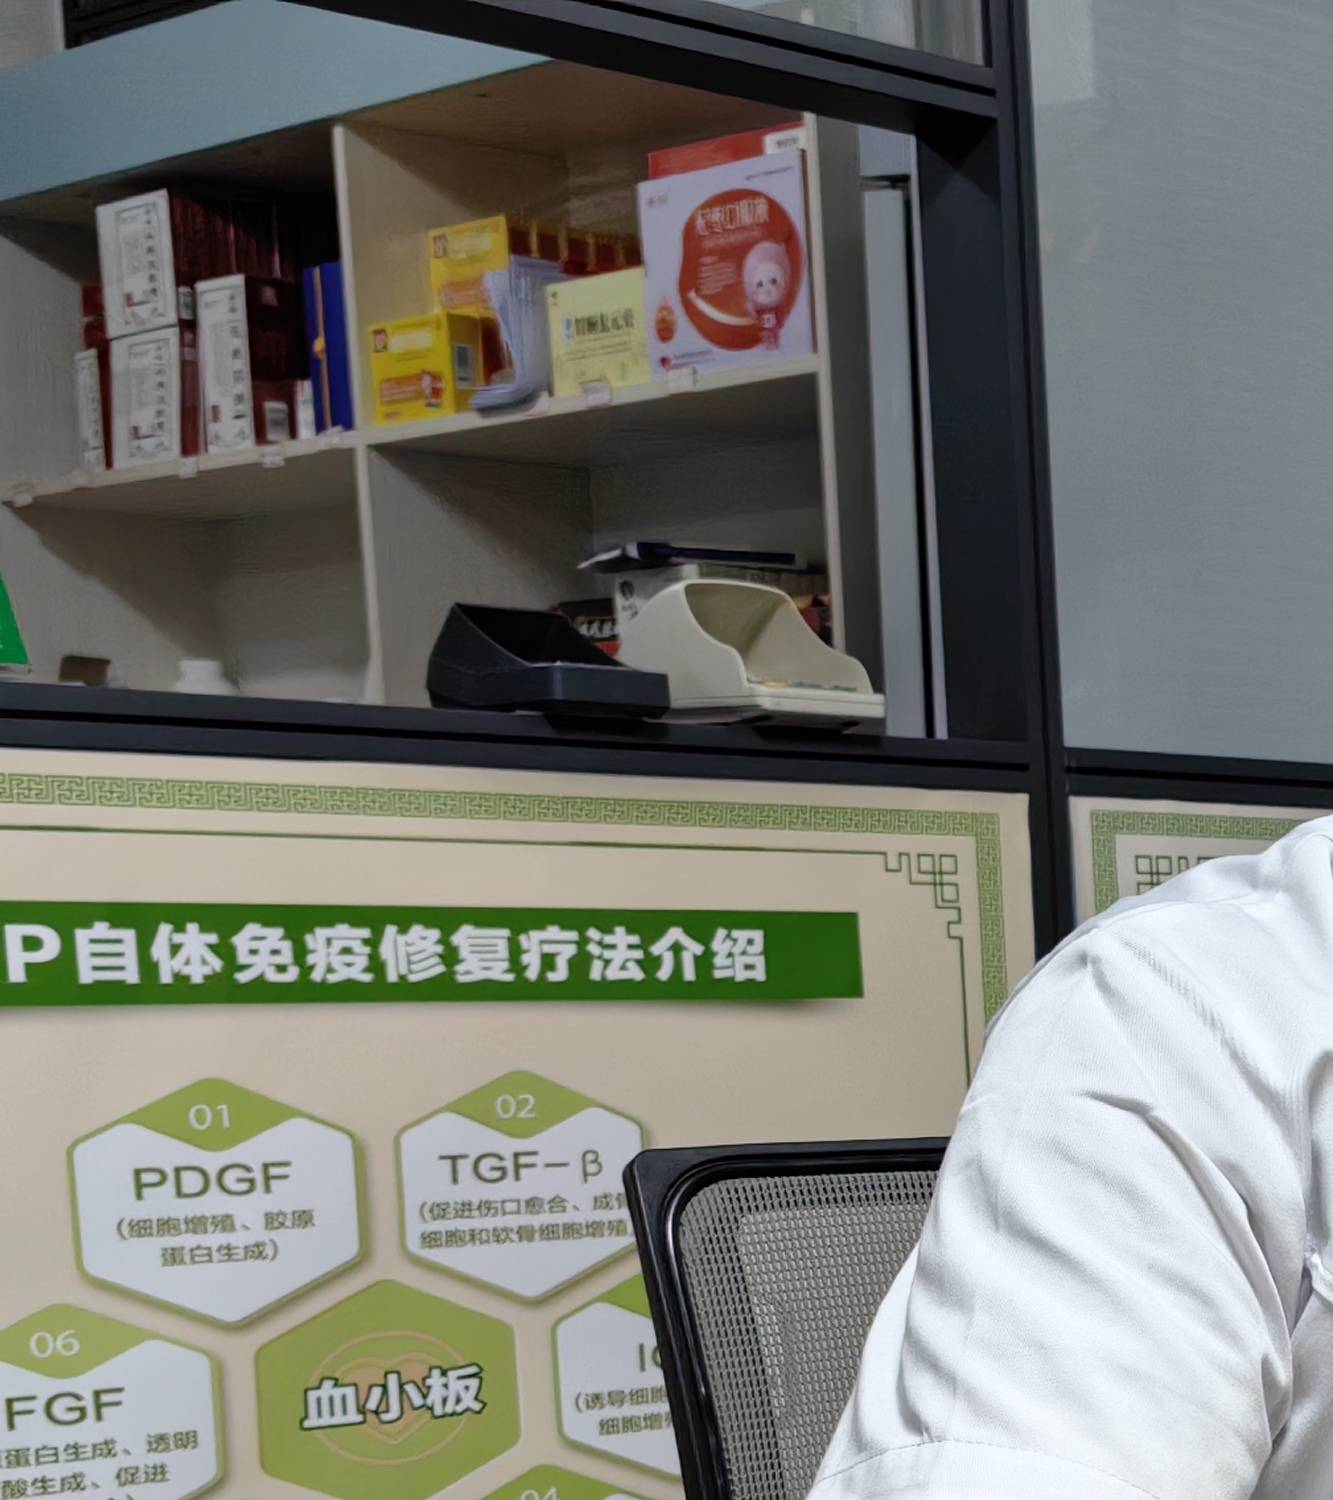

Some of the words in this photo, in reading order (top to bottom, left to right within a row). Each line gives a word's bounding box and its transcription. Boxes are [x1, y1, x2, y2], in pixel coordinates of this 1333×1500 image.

[3, 922, 768, 985] P自体免疫修复疗法介绍
[188, 1104, 232, 1130] 01
[495, 1094, 536, 1122] 02
[132, 1161, 293, 1201] PDGF
[115, 1208, 317, 1242] (细胞增殖、胶原
[420, 1218, 635, 1249] 细胞和软骨细胞增殖
[160, 1241, 280, 1269] 蛋白生成)
[30, 1330, 80, 1358] 06
[5, 1387, 126, 1431] FGF
[300, 1364, 487, 1430] 血小板
[0, 1430, 199, 1469] 蛋白生成、透明
